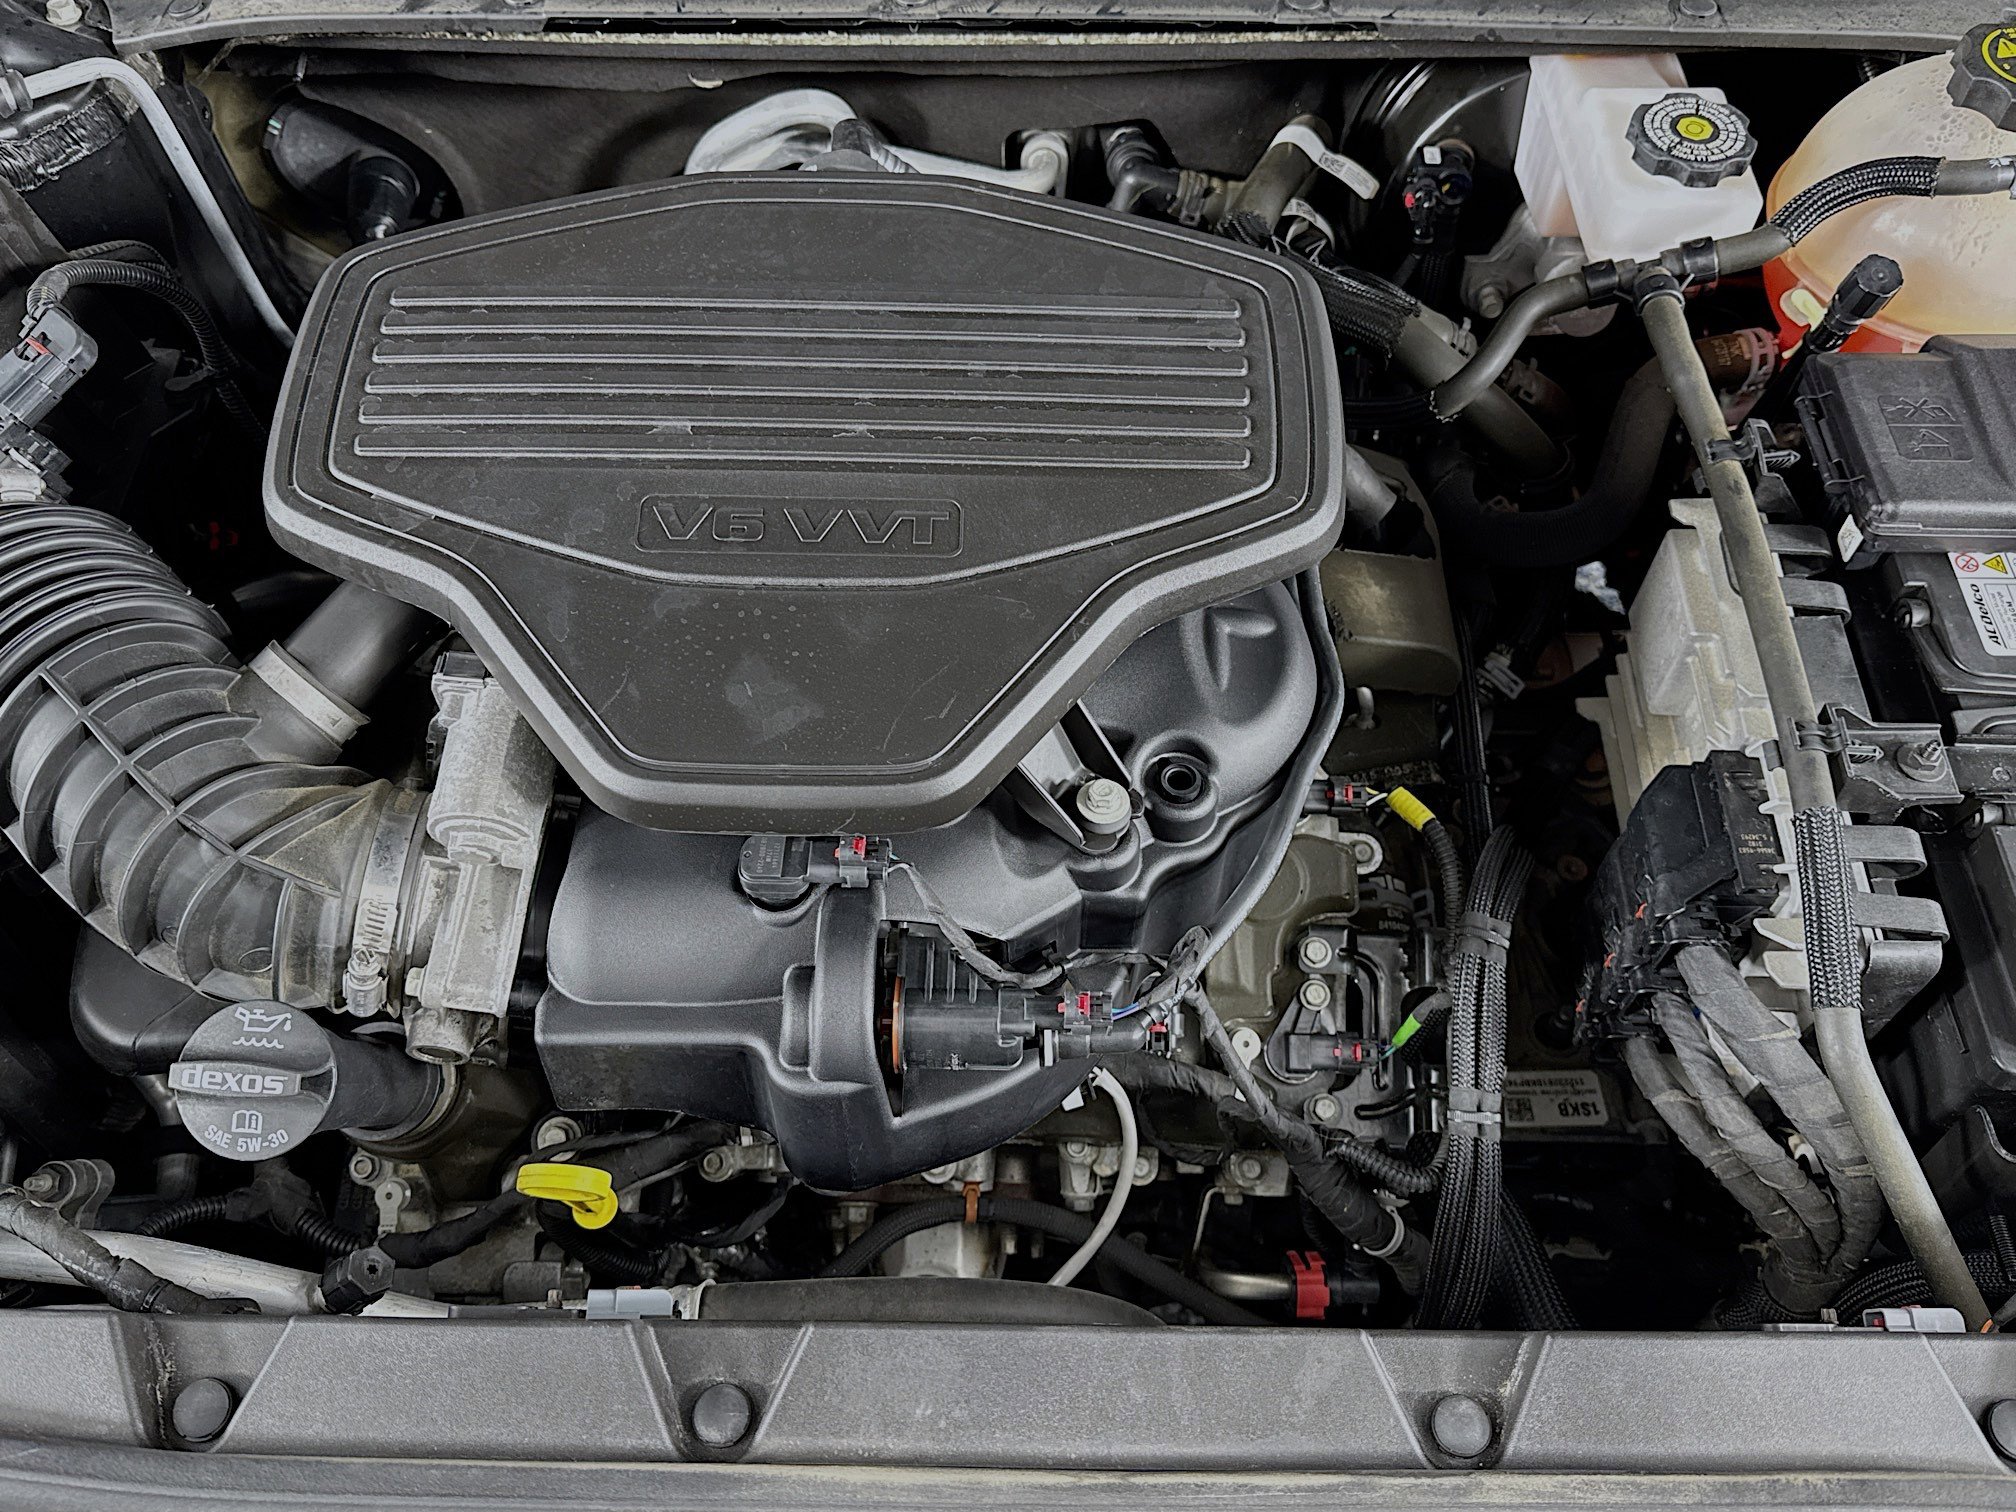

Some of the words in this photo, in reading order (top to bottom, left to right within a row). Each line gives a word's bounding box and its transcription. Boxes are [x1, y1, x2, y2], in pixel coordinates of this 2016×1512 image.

[652, 506, 764, 541] V6
[784, 508, 949, 544] VVT
[1970, 583, 2001, 646] ACDelco
[181, 1064, 288, 1095] dexos
[1558, 1101, 1600, 1118] 1SKB
[204, 1124, 232, 1149] SAE
[236, 1129, 289, 1153] 5W-30
